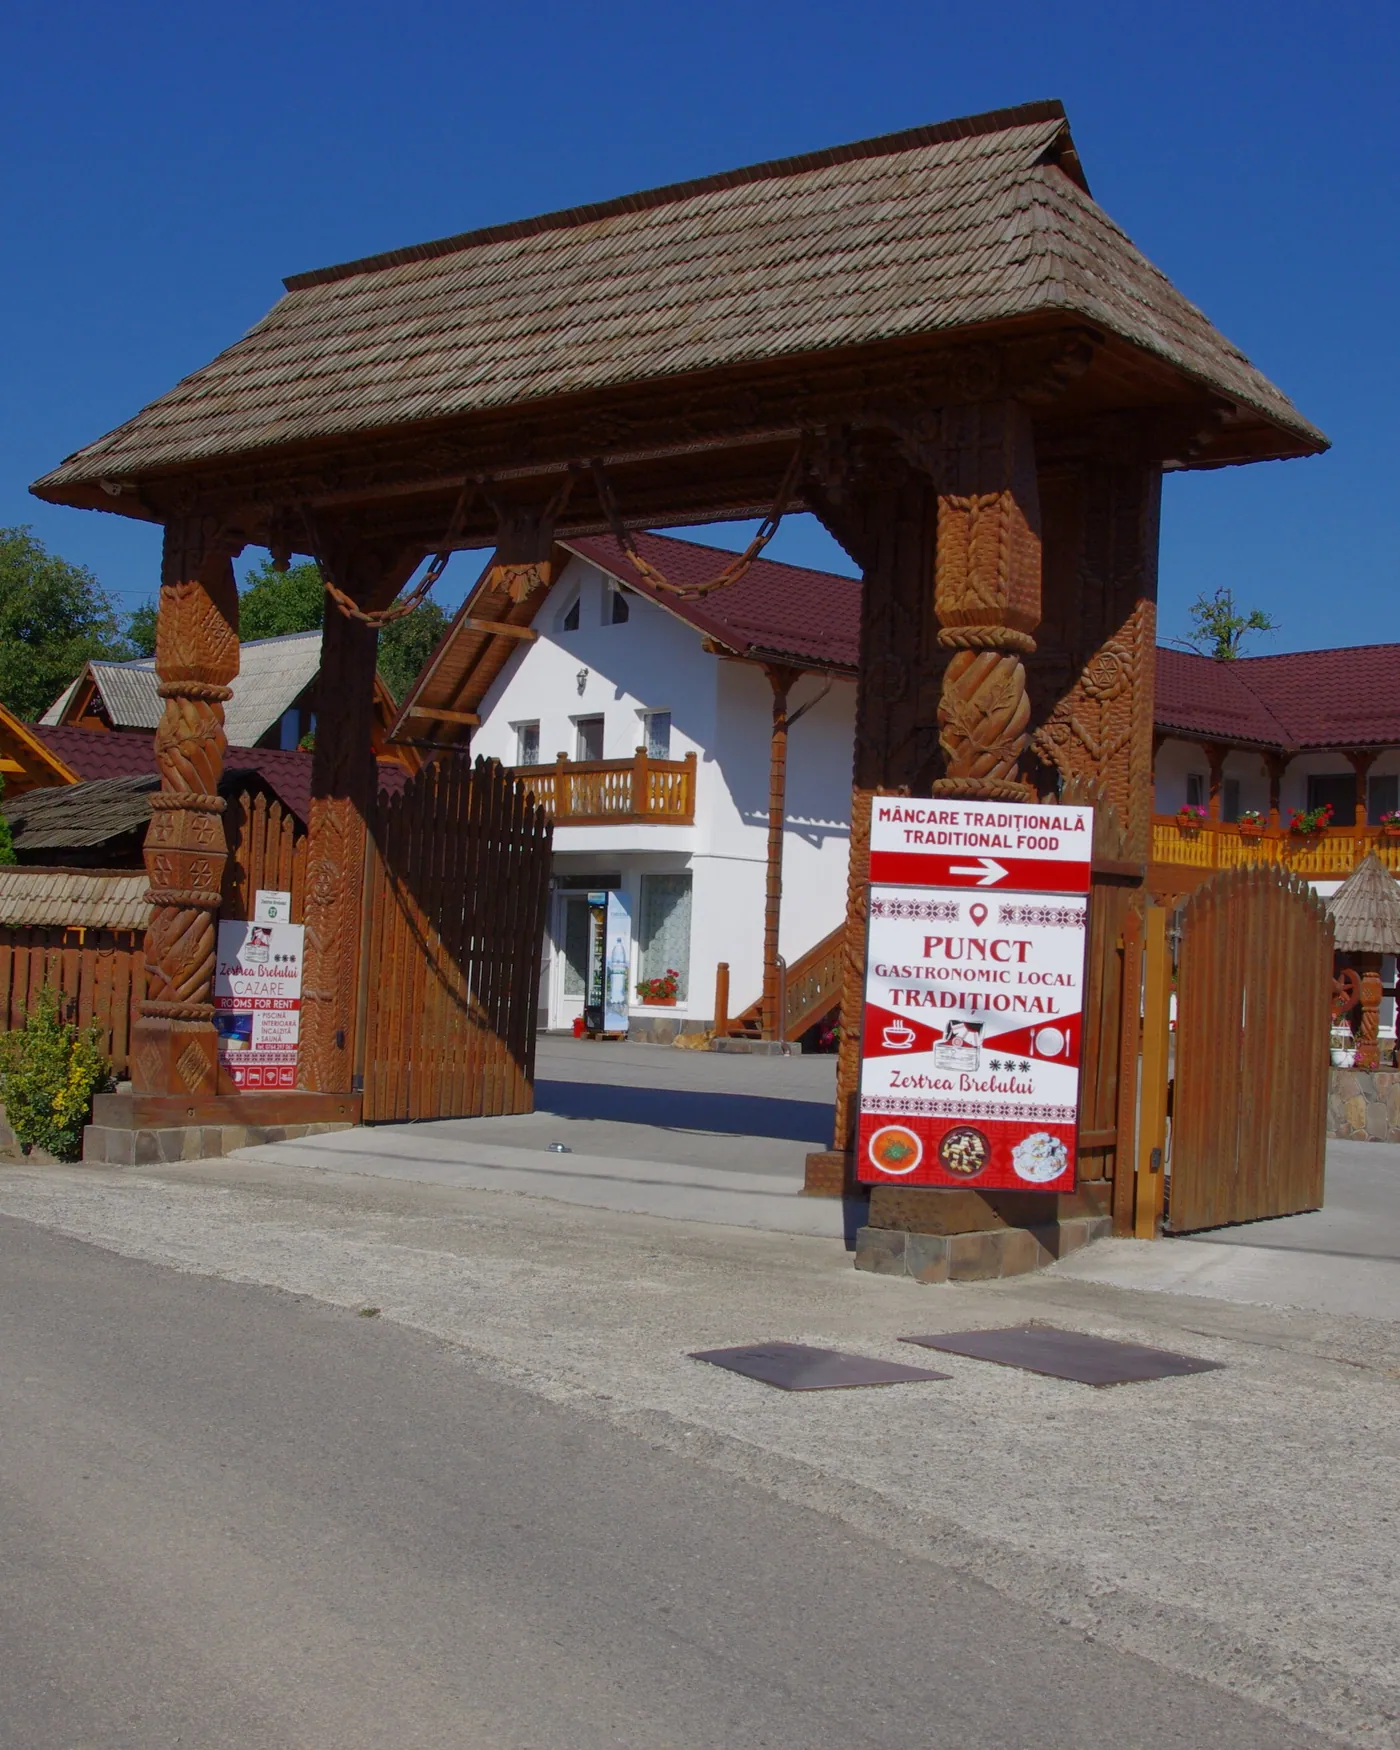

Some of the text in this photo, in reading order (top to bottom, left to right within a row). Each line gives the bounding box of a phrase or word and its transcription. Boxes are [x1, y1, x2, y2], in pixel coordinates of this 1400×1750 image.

[878, 806, 959, 826] MÂNCARE
[904, 829, 1059, 851] TRADITIONAL FOOD
[922, 935, 1033, 964] PUNCT
[219, 963, 298, 978] Zestrea Brebului
[875, 963, 1076, 988] GASTRONOMIC LOCAL
[234, 981, 285, 996] CAZARE
[221, 998, 294, 1009] ROOMS FOR RENT
[889, 1070, 1036, 1095] Zestrea Brebului
